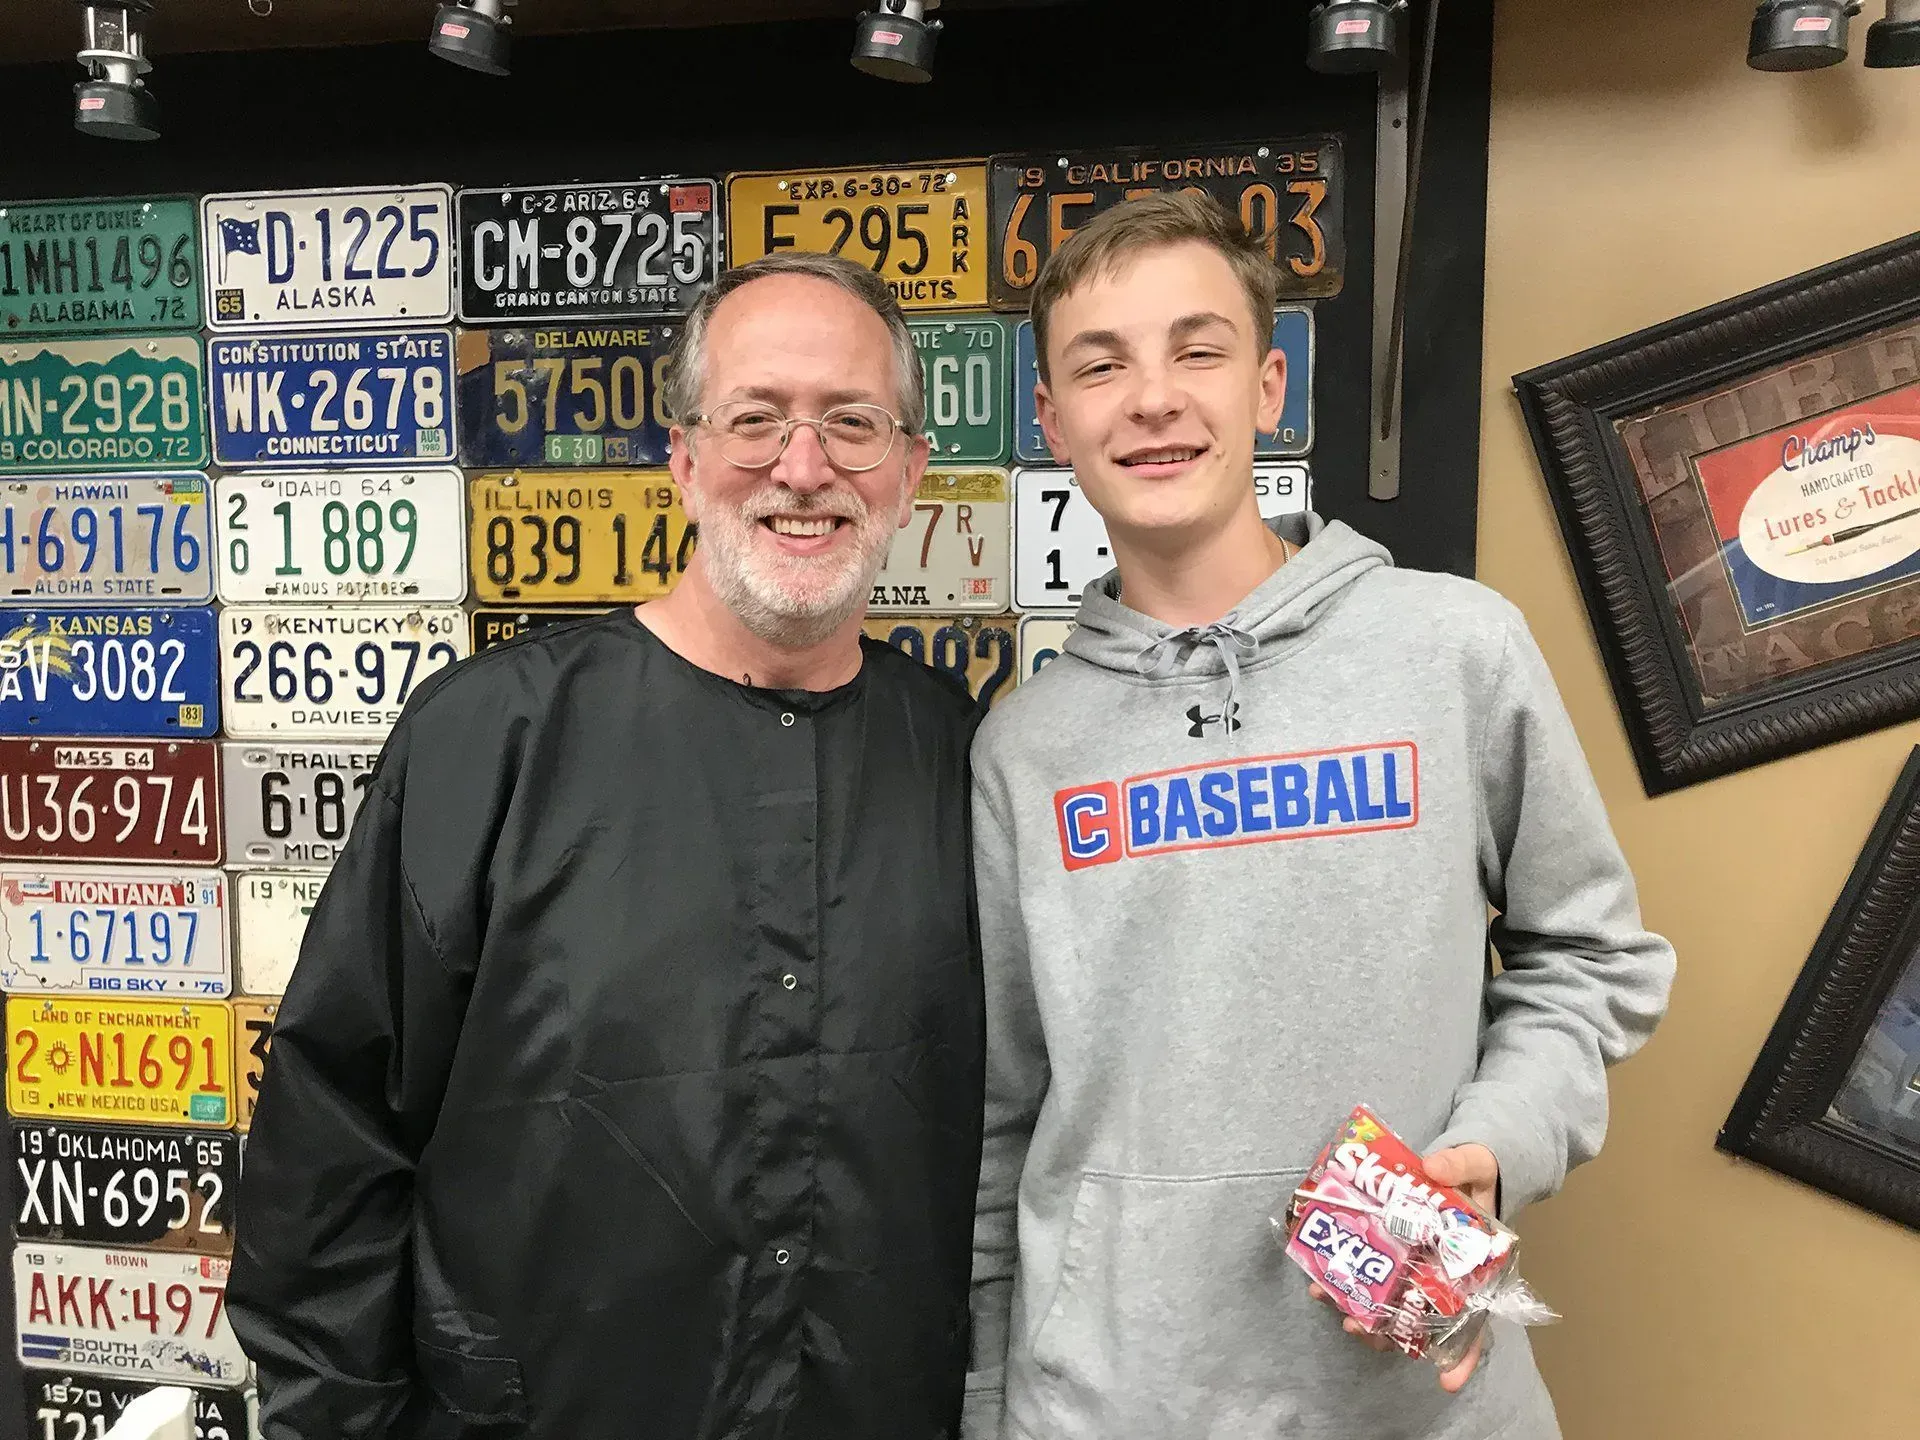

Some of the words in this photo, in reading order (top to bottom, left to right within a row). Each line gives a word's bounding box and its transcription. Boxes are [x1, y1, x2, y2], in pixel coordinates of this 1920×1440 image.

[1018, 168, 1044, 188] 19
[1067, 156, 1257, 185] CALIFORNIA
[1278, 152, 1318, 174] 35
[790, 179, 838, 200] EXP.
[522, 193, 558, 214] C-2
[622, 188, 650, 209] 64
[9, 214, 65, 233] HEART
[71, 212, 92, 231] OF
[99, 209, 142, 229] DIXIE
[473, 211, 705, 291] CM-8725
[218, 296, 242, 314] 65
[276, 286, 377, 310] ALASKA
[495, 291, 551, 308] GRAND
[555, 288, 623, 306] CANYON
[628, 286, 679, 304] STATE
[28, 300, 134, 322] ALABAMA
[534, 329, 651, 350] DELAWARE
[964, 329, 993, 348] 70
[218, 343, 360, 364] CONSTITUTION
[376, 340, 443, 360] STATE
[920, 354, 993, 427] 60
[267, 435, 400, 455] CONNECTICUT
[421, 430, 440, 443] AUG
[1781, 421, 1876, 473] Champs
[23, 438, 153, 460] COLORADO
[162, 438, 189, 456] 72
[56, 482, 128, 500] HAWAII
[278, 480, 341, 496] IDAHO
[361, 479, 392, 496] 64
[1800, 462, 1874, 498] HANDCRAFTED
[485, 488, 613, 511] ILLINOIS
[644, 487, 682, 509] 19
[1764, 506, 1828, 541] Lures
[1834, 496, 1856, 520] &
[1858, 469, 1920, 510] Tackl
[273, 501, 302, 576] 1
[322, 499, 418, 576] 889
[486, 515, 581, 585] 839
[35, 580, 93, 594] ALOHA
[104, 579, 155, 594] STATE
[275, 582, 329, 595] FAMOUS
[337, 582, 408, 596] POTATOES
[48, 616, 152, 636] KANSAS
[232, 618, 252, 634] 19
[278, 617, 405, 634] KENTUCKY
[427, 615, 453, 634] 60
[71, 639, 186, 703] 3082
[186, 706, 198, 720] 83
[55, 750, 113, 766] MASS
[125, 752, 151, 767] 64
[1062, 792, 1110, 860] C
[1129, 752, 1412, 848] BASEBALL
[61, 881, 177, 905] MONTANA
[186, 881, 195, 904] 3
[202, 889, 215, 905] 91
[250, 882, 272, 899] 19
[89, 976, 121, 991] BIG
[126, 979, 168, 992] SKY
[33, 1009, 69, 1025] LAND
[75, 1010, 92, 1025] OF
[98, 1011, 201, 1030] ENCHANTMENT
[80, 1031, 222, 1092] N1691
[21, 1089, 39, 1105] 19
[57, 1092, 86, 1109] NEW
[92, 1094, 145, 1111] MEXICO
[150, 1097, 180, 1113] USA
[20, 1130, 43, 1155] 19
[58, 1133, 181, 1164] OKLAHOMA
[196, 1140, 223, 1166] 65
[1297, 1208, 1395, 1286] Extra
[25, 1253, 45, 1266] 19
[105, 1253, 149, 1269] BROWN
[1324, 1271, 1352, 1294] CLASSIC
[1350, 1288, 1377, 1311] BUBBLE
[73, 1338, 137, 1355] SOUTH
[73, 1351, 153, 1370] DAKOTA
